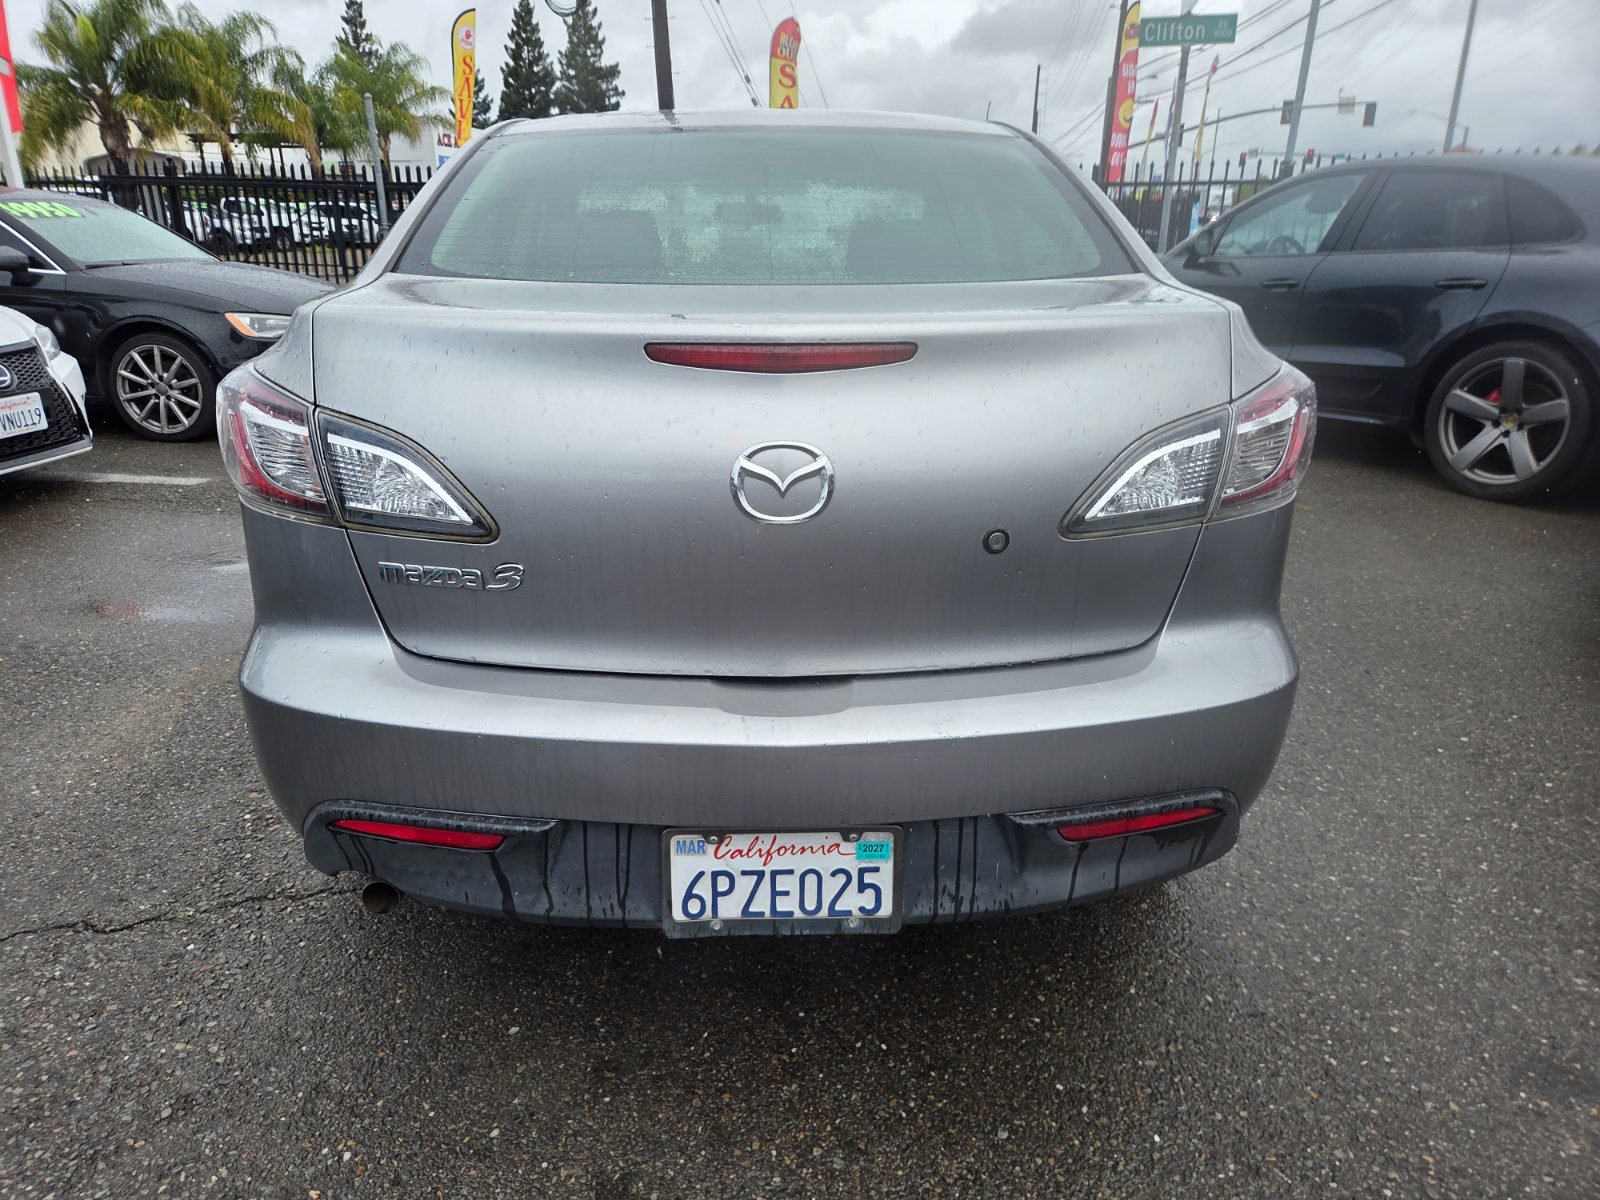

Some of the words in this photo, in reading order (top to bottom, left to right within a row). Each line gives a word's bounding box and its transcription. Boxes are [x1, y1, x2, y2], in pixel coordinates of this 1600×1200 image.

[1145, 23, 1205, 42] Clifton
[676, 840, 706, 856] MAR
[713, 835, 856, 867] California
[862, 844, 885, 853] 2027
[681, 866, 882, 920] 6PZE025
